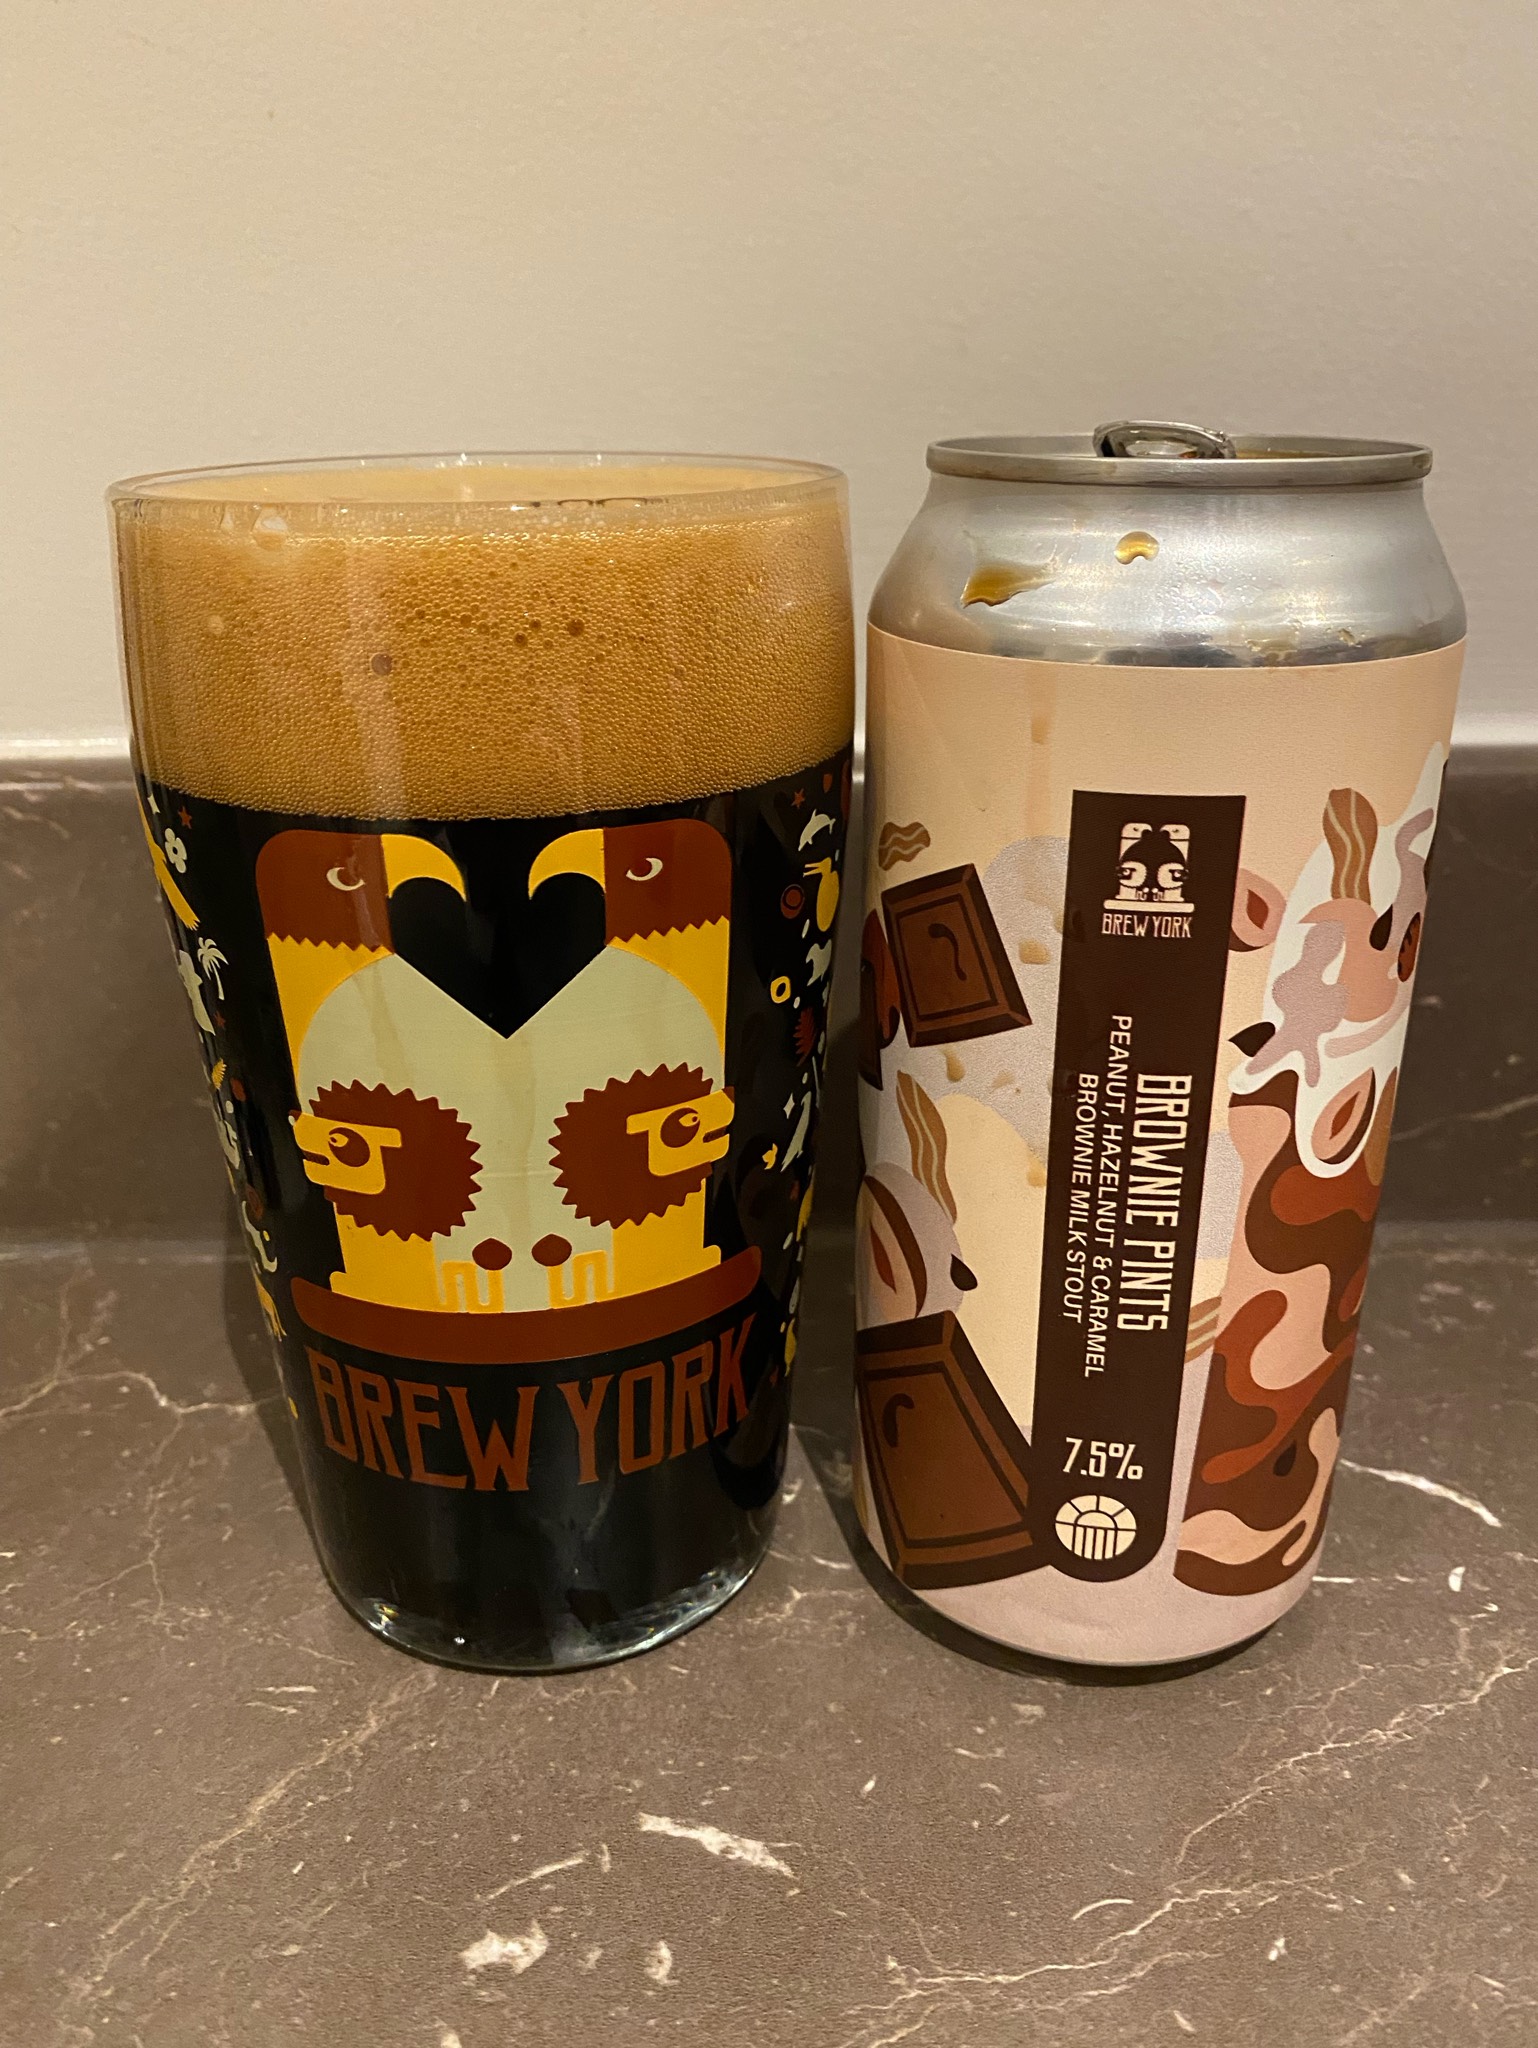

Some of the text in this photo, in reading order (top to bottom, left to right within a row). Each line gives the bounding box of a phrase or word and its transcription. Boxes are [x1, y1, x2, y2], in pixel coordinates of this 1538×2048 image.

[1101, 912, 1193, 938] BREW YORK
[1063, 1072, 1099, 1323] BROWNIE MILK STOUT
[1084, 1014, 1132, 1379] PEANUT, HAZELNUT & CARAMEL
[1116, 1073, 1192, 1332] BROWNIE PINTS
[304, 1312, 757, 1492] BREW YORK
[1062, 1436, 1144, 1480] 7.5%
